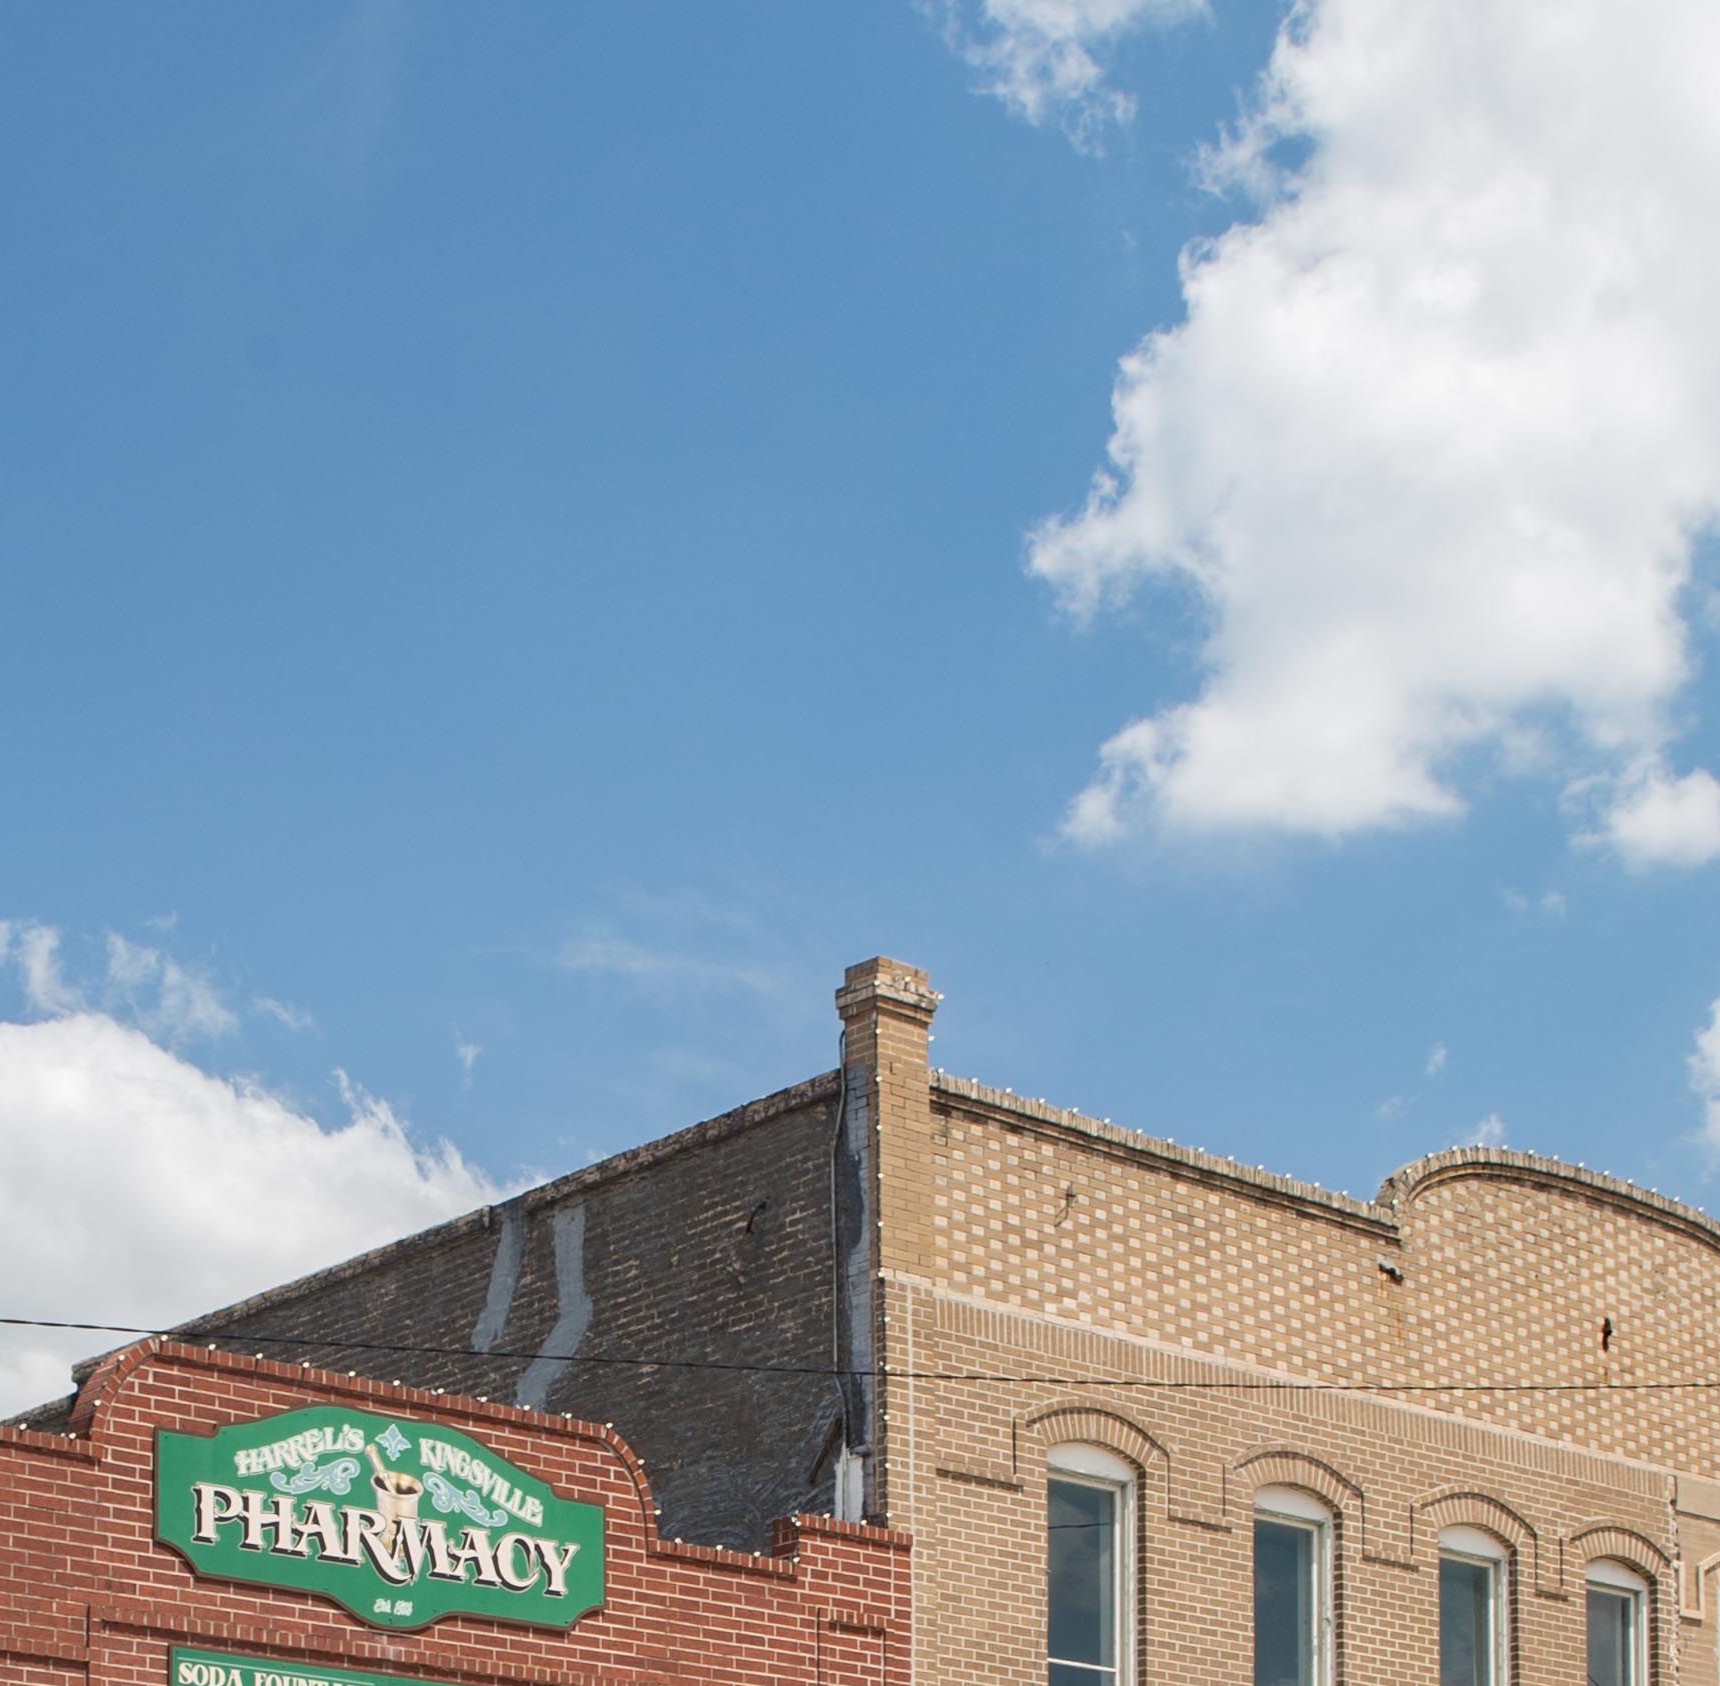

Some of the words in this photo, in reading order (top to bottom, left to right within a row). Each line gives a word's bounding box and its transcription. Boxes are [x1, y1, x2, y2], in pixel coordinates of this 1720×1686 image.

[234, 1424, 365, 1477] HARREL'S
[419, 1438, 543, 1528] KINGSVILLE
[191, 1481, 579, 1598] PHARMACY
